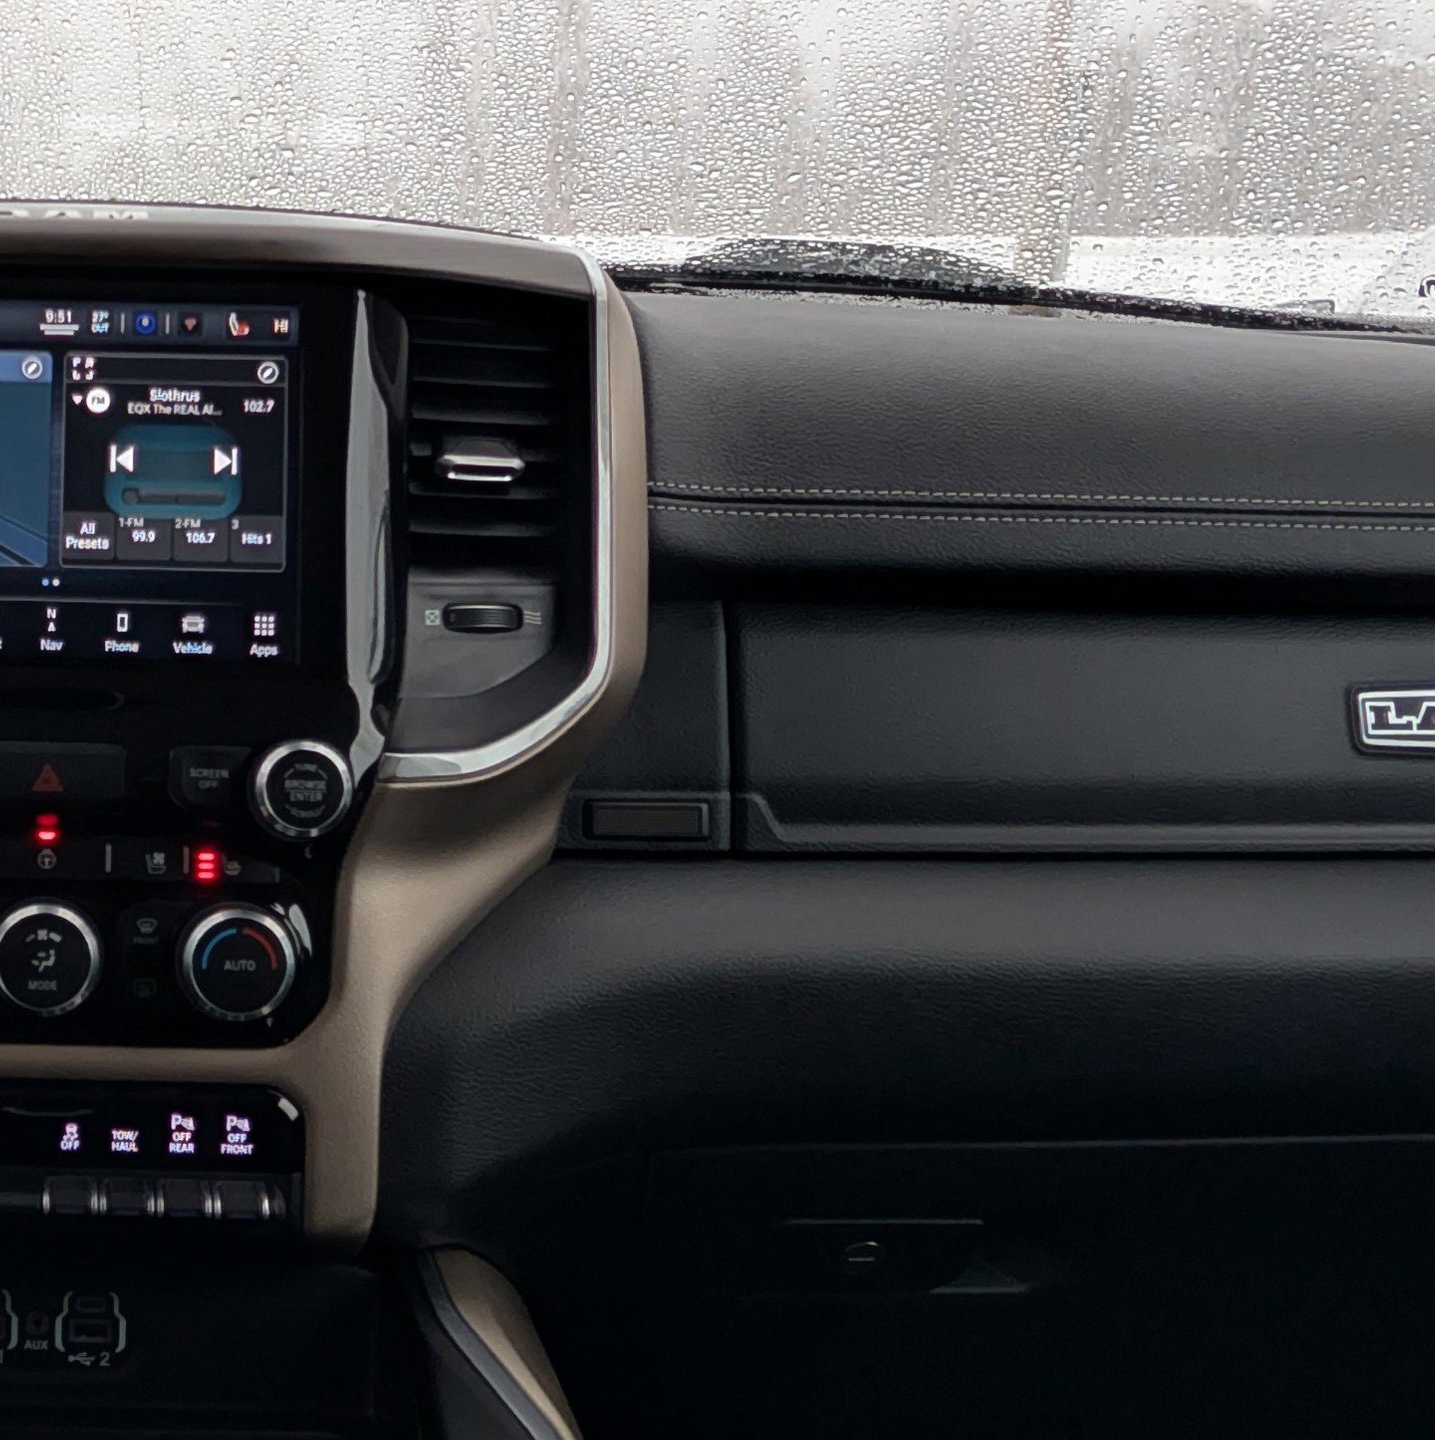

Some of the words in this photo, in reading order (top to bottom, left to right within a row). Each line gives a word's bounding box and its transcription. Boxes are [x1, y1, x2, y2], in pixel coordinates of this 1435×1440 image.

[152, 402, 173, 416] The
[173, 402, 201, 416] REAL
[242, 398, 275, 414] 102.7
[79, 522, 96, 535] All
[65, 536, 110, 550] Presets
[131, 530, 157, 543] 99.9
[240, 532, 265, 545] Hits
[40, 639, 64, 652] Nav
[103, 639, 141, 654] Phone
[172, 641, 214, 656] Vehicle
[249, 643, 279, 659] Apps
[189, 767, 230, 779] SCREEN
[223, 959, 257, 972] AUTO
[27, 980, 58, 992] MODE
[111, 1129, 140, 1141] TOW/
[171, 1131, 193, 1142] OFF
[226, 1132, 248, 1144] OFF
[59, 1139, 81, 1151] OFF
[111, 1140, 140, 1153] HAUL
[168, 1142, 196, 1154] REAR
[219, 1143, 254, 1156] FRONT
[23, 1339, 50, 1351] AUX
[98, 1351, 111, 1368] 2
